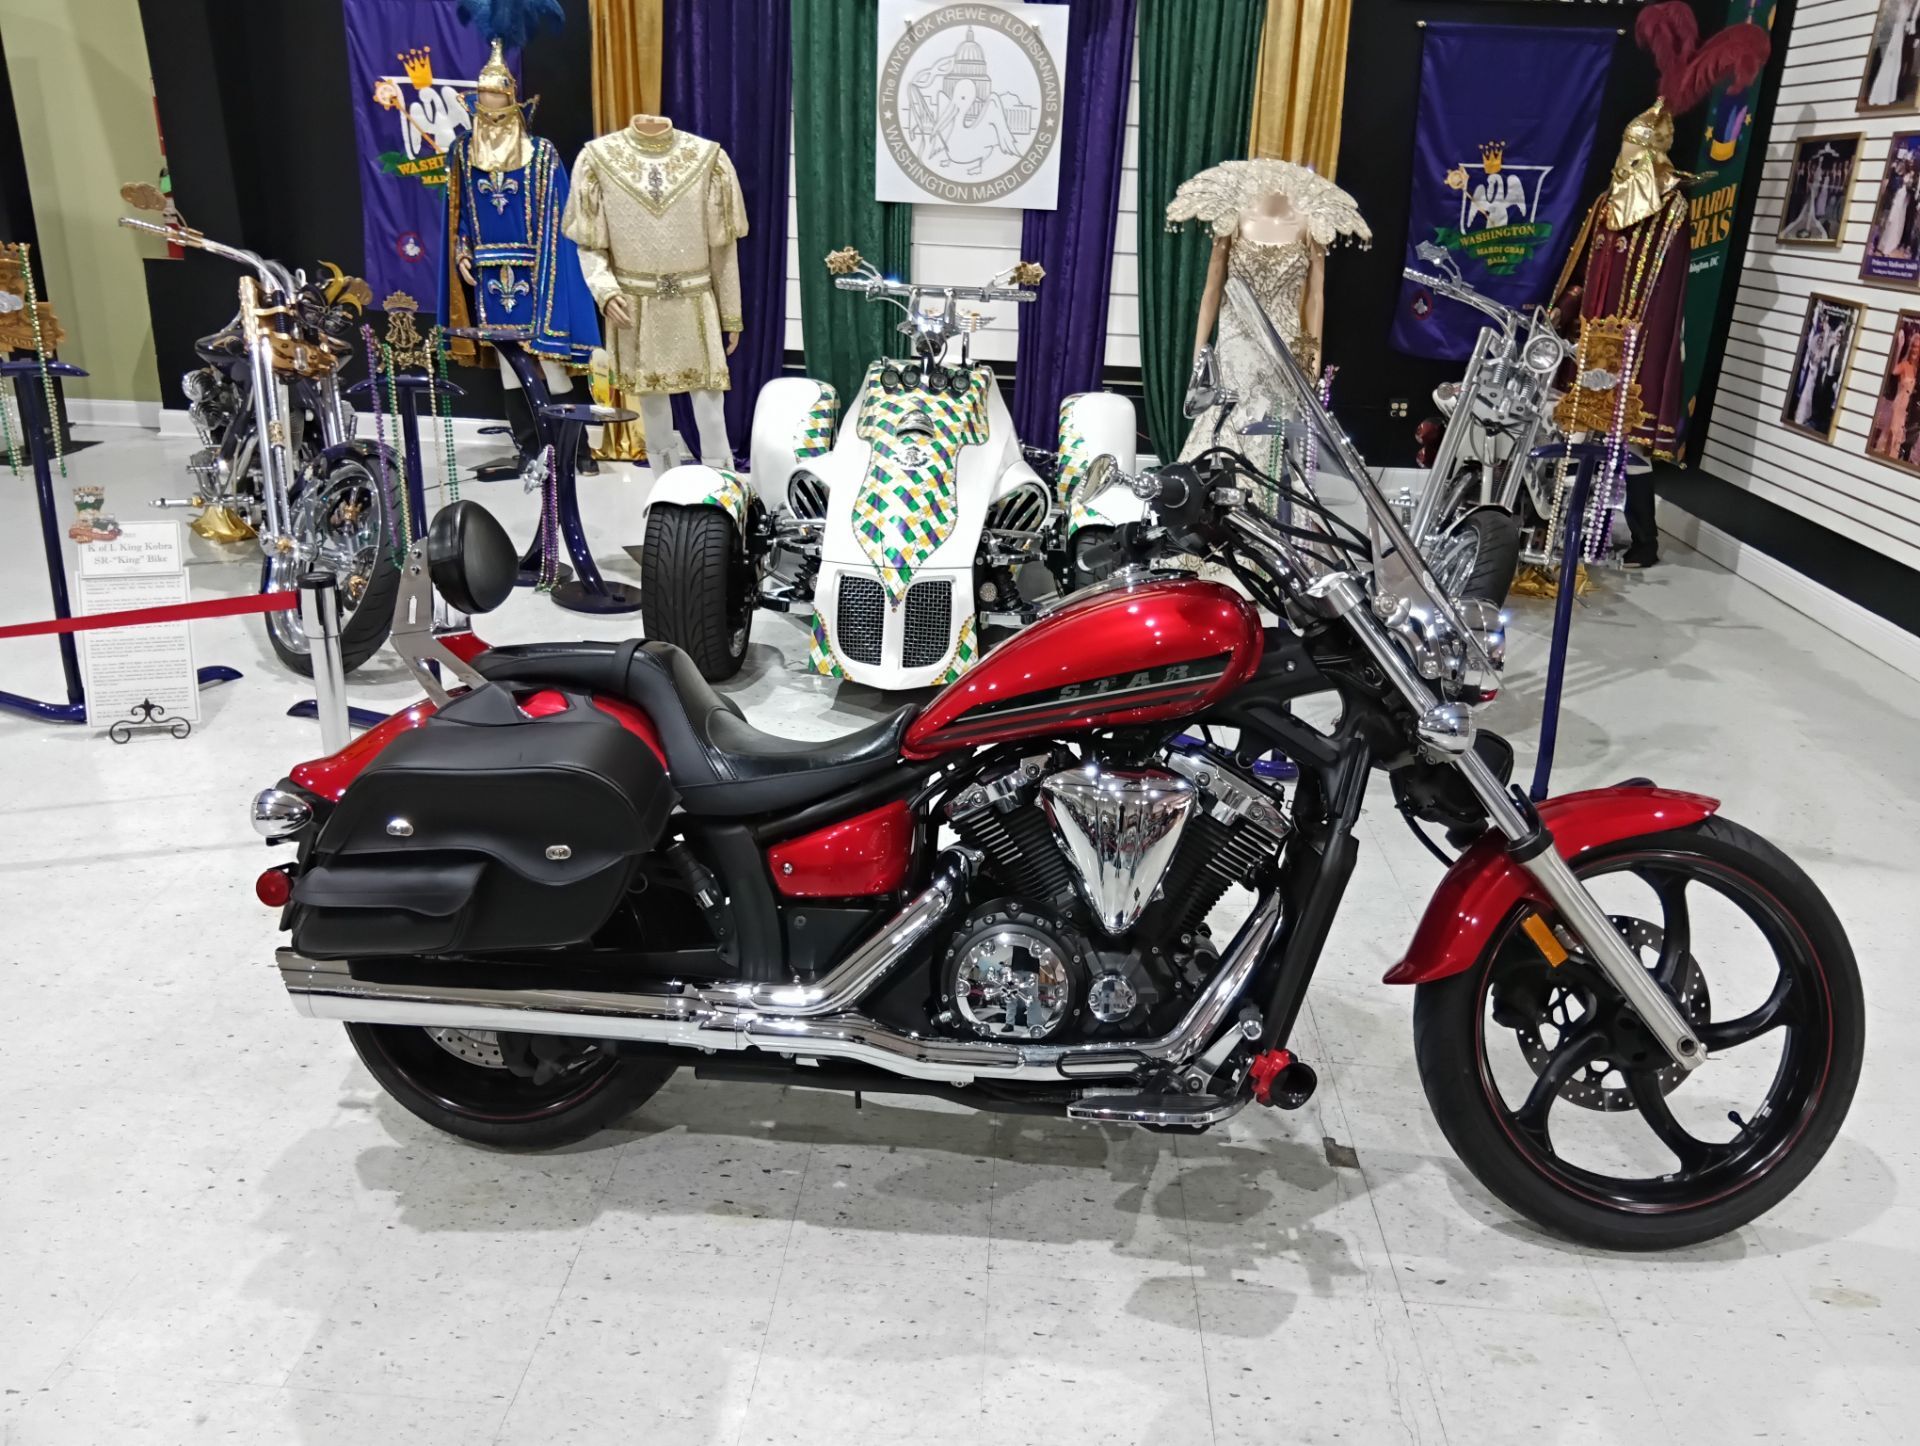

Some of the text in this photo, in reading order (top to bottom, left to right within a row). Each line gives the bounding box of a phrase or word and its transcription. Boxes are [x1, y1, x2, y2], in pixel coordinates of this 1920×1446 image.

[883, 7, 1058, 112] The MYSTICK KREWE of LOUISIANIANS
[396, 156, 445, 175] WASHI
[885, 124, 1052, 200] WASHINGTON MARDI GRAS
[422, 175, 446, 184] MAR
[1459, 224, 1536, 247] WASHINGTON
[1476, 247, 1502, 255] MARDI
[1487, 256, 1507, 266] BALL
[120, 543, 142, 553] King
[145, 542, 173, 551] Kobra
[147, 554, 168, 563] Bike
[1058, 665, 1190, 701] STAR
